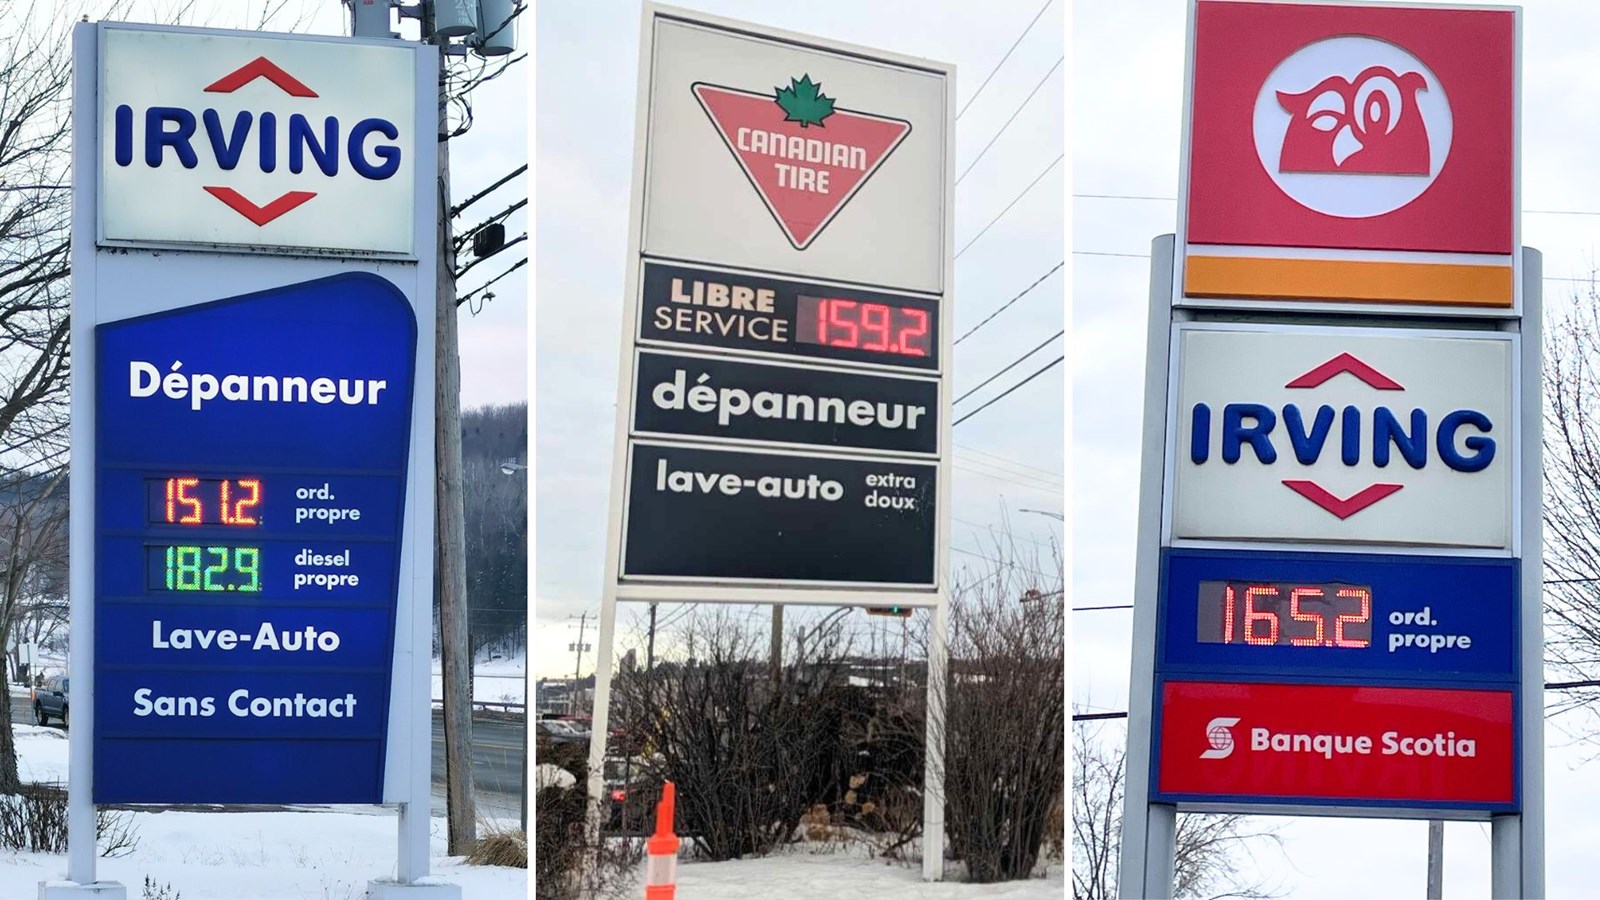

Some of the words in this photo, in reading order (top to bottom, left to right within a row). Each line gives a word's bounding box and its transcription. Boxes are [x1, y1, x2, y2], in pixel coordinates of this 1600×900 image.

[115, 104, 401, 180] IRVING
[736, 125, 868, 172] CANADIAN
[774, 162, 830, 195] TIRE
[670, 278, 776, 313] LIBRE
[653, 307, 789, 342] SERVICE
[815, 298, 929, 356] 159.2
[129, 360, 387, 411] Dépanneur
[652, 370, 927, 430] dépanneur
[1191, 402, 1497, 473] IRVING
[295, 483, 335, 500] ord.
[656, 458, 844, 502] lave-auto
[865, 472, 917, 490] extra
[165, 478, 260, 526] 151.2
[295, 506, 361, 524] propre
[864, 491, 916, 511] doux
[165, 545, 259, 592] 182.9
[294, 549, 350, 567] diesel
[294, 572, 359, 591] propre
[1224, 586, 1371, 648] 165.2
[1389, 606, 1438, 626] ord.
[152, 620, 340, 653] Lave-Auto
[1388, 632, 1472, 653] propre
[133, 687, 216, 718] Sans
[228, 688, 358, 719] Contact
[1250, 727, 1374, 760] Banque
[1381, 731, 1477, 758] Scotia
